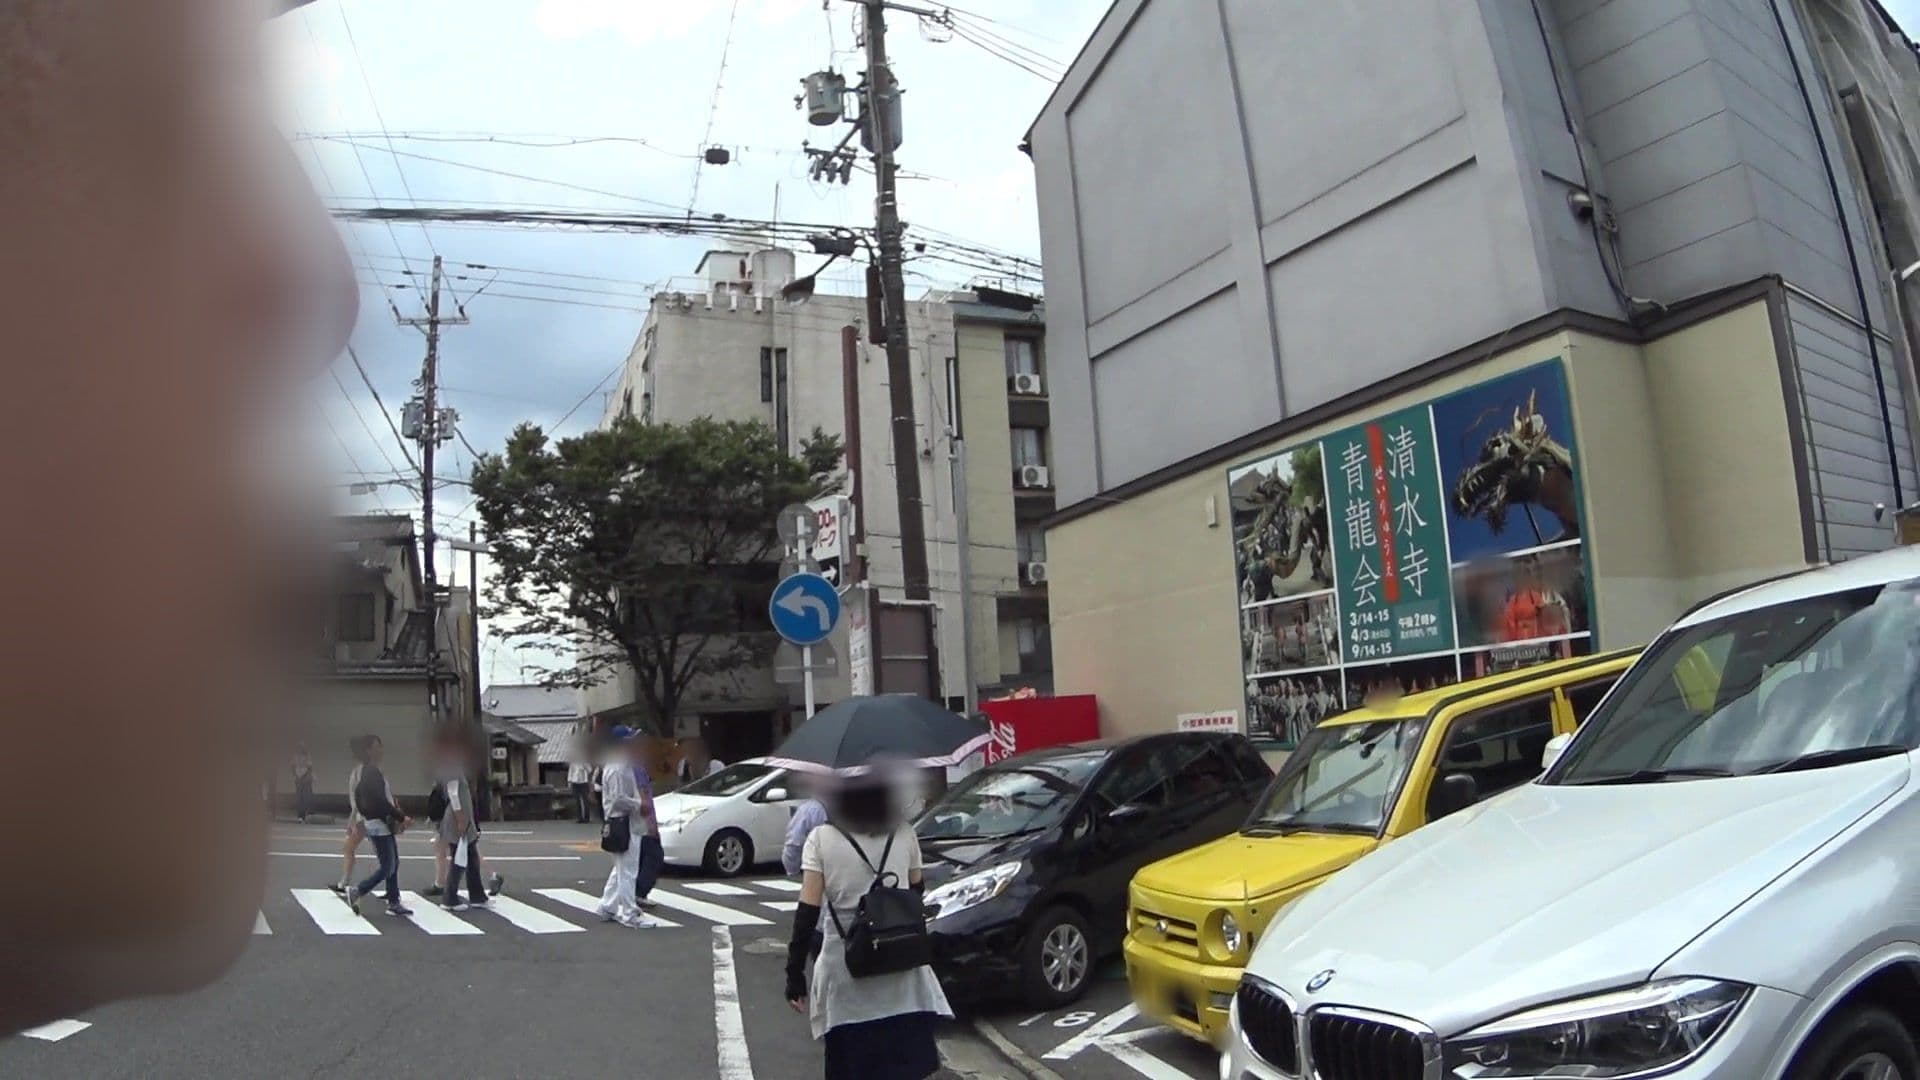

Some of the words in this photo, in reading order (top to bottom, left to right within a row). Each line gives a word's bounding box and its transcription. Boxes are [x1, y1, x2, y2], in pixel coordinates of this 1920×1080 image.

[1340, 441, 1380, 607] 青龍会
[1386, 424, 1429, 597] 清水寺
